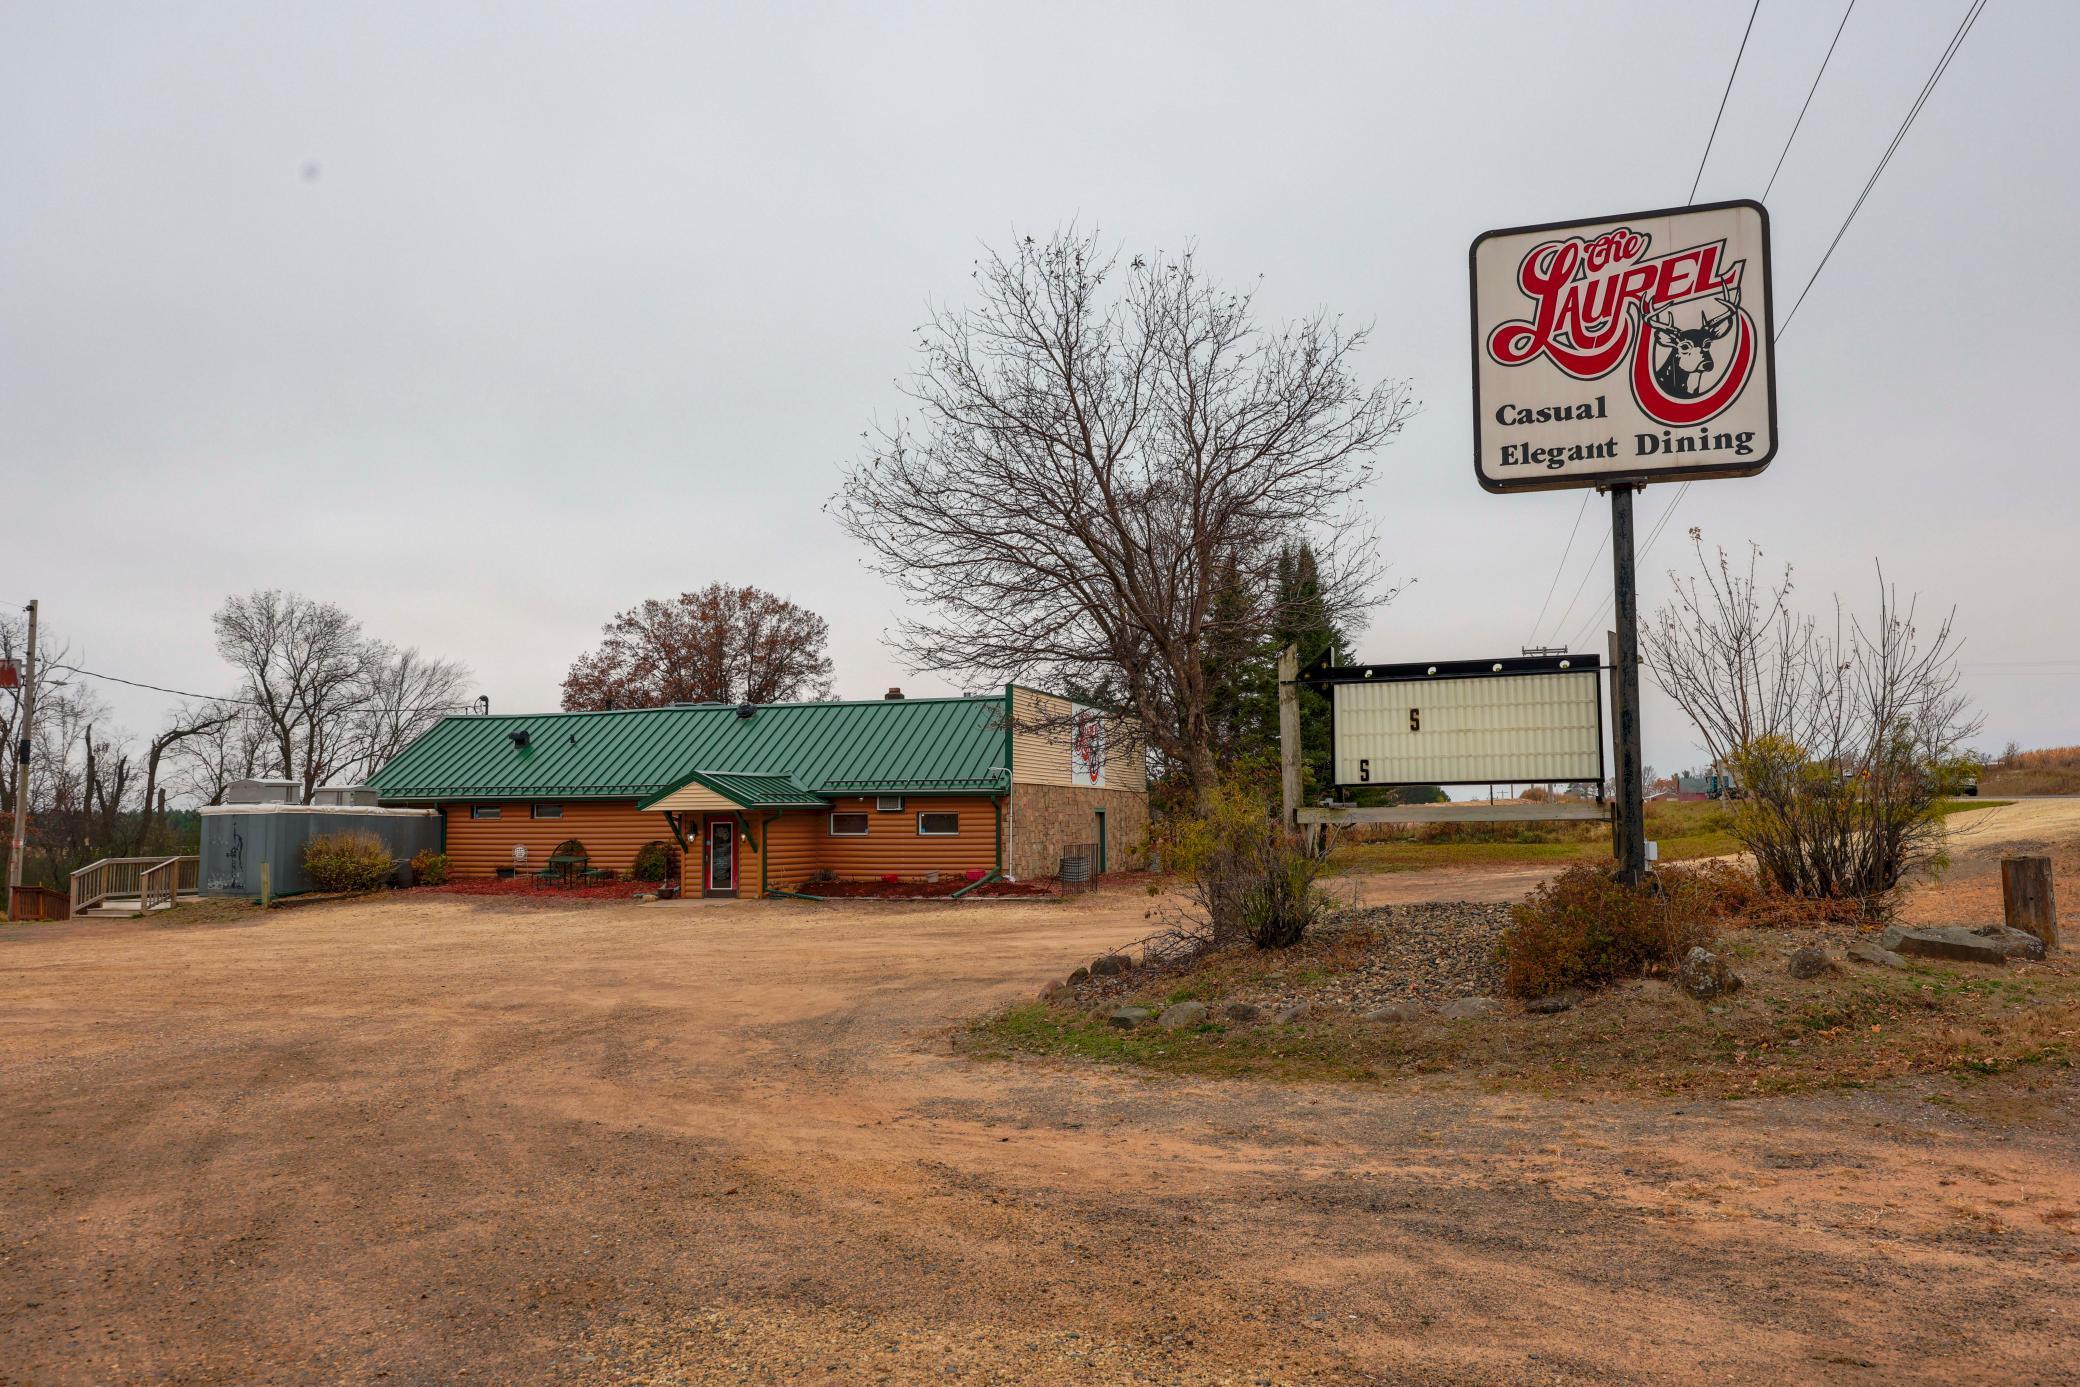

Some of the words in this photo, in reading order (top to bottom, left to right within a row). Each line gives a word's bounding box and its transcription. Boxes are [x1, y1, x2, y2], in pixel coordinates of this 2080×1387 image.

[1583, 230, 1645, 273] The
[1490, 240, 1740, 377] LAUREL
[1494, 395, 1609, 427] Casual
[1499, 436, 1618, 470] Elegant
[1634, 427, 1756, 456] Dining
